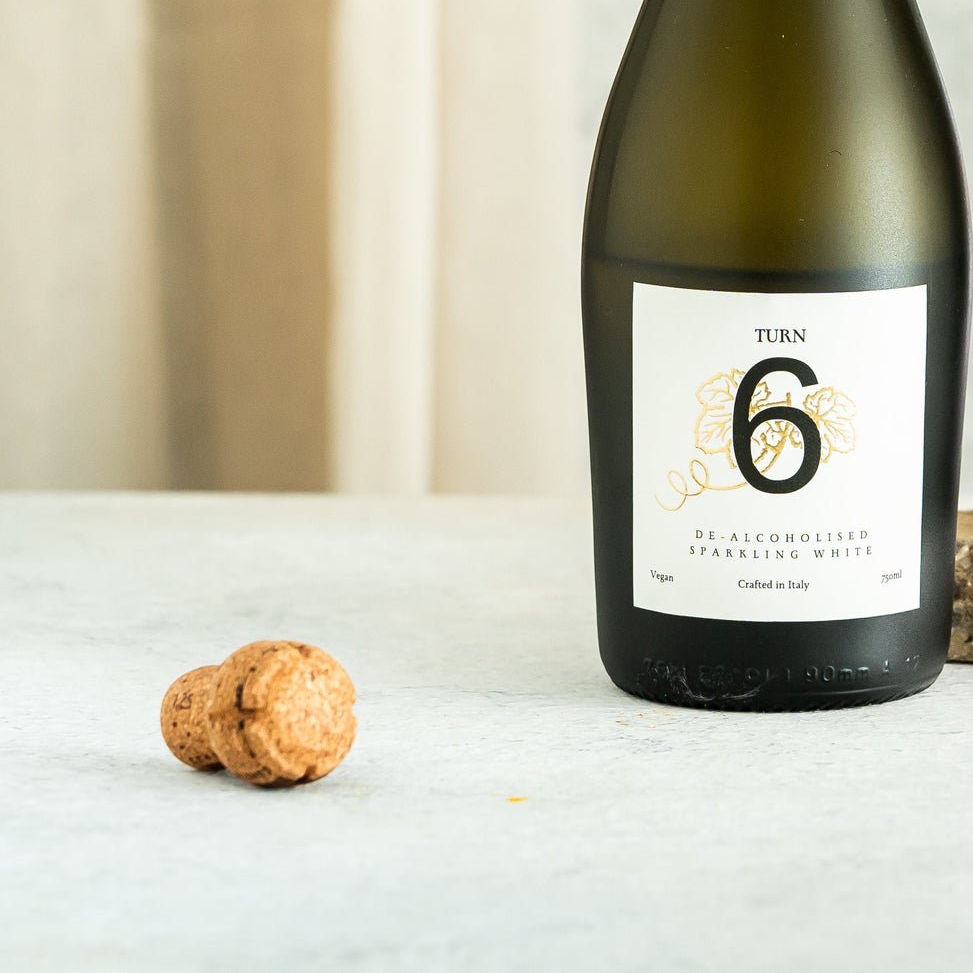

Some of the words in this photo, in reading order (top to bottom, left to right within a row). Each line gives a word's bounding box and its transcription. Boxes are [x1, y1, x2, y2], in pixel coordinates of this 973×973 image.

[755, 328, 806, 344] TURN
[732, 356, 822, 494] 6
[695, 529, 868, 544] DE-ALCOHOLISED
[689, 545, 799, 560] SPARKLING
[814, 545, 872, 559] WHITE
[650, 569, 674, 583] Vegan
[880, 569, 903, 584] 750ml
[737, 578, 773, 590] Crafted
[775, 579, 786, 590] in
[788, 579, 810, 592] Italy
